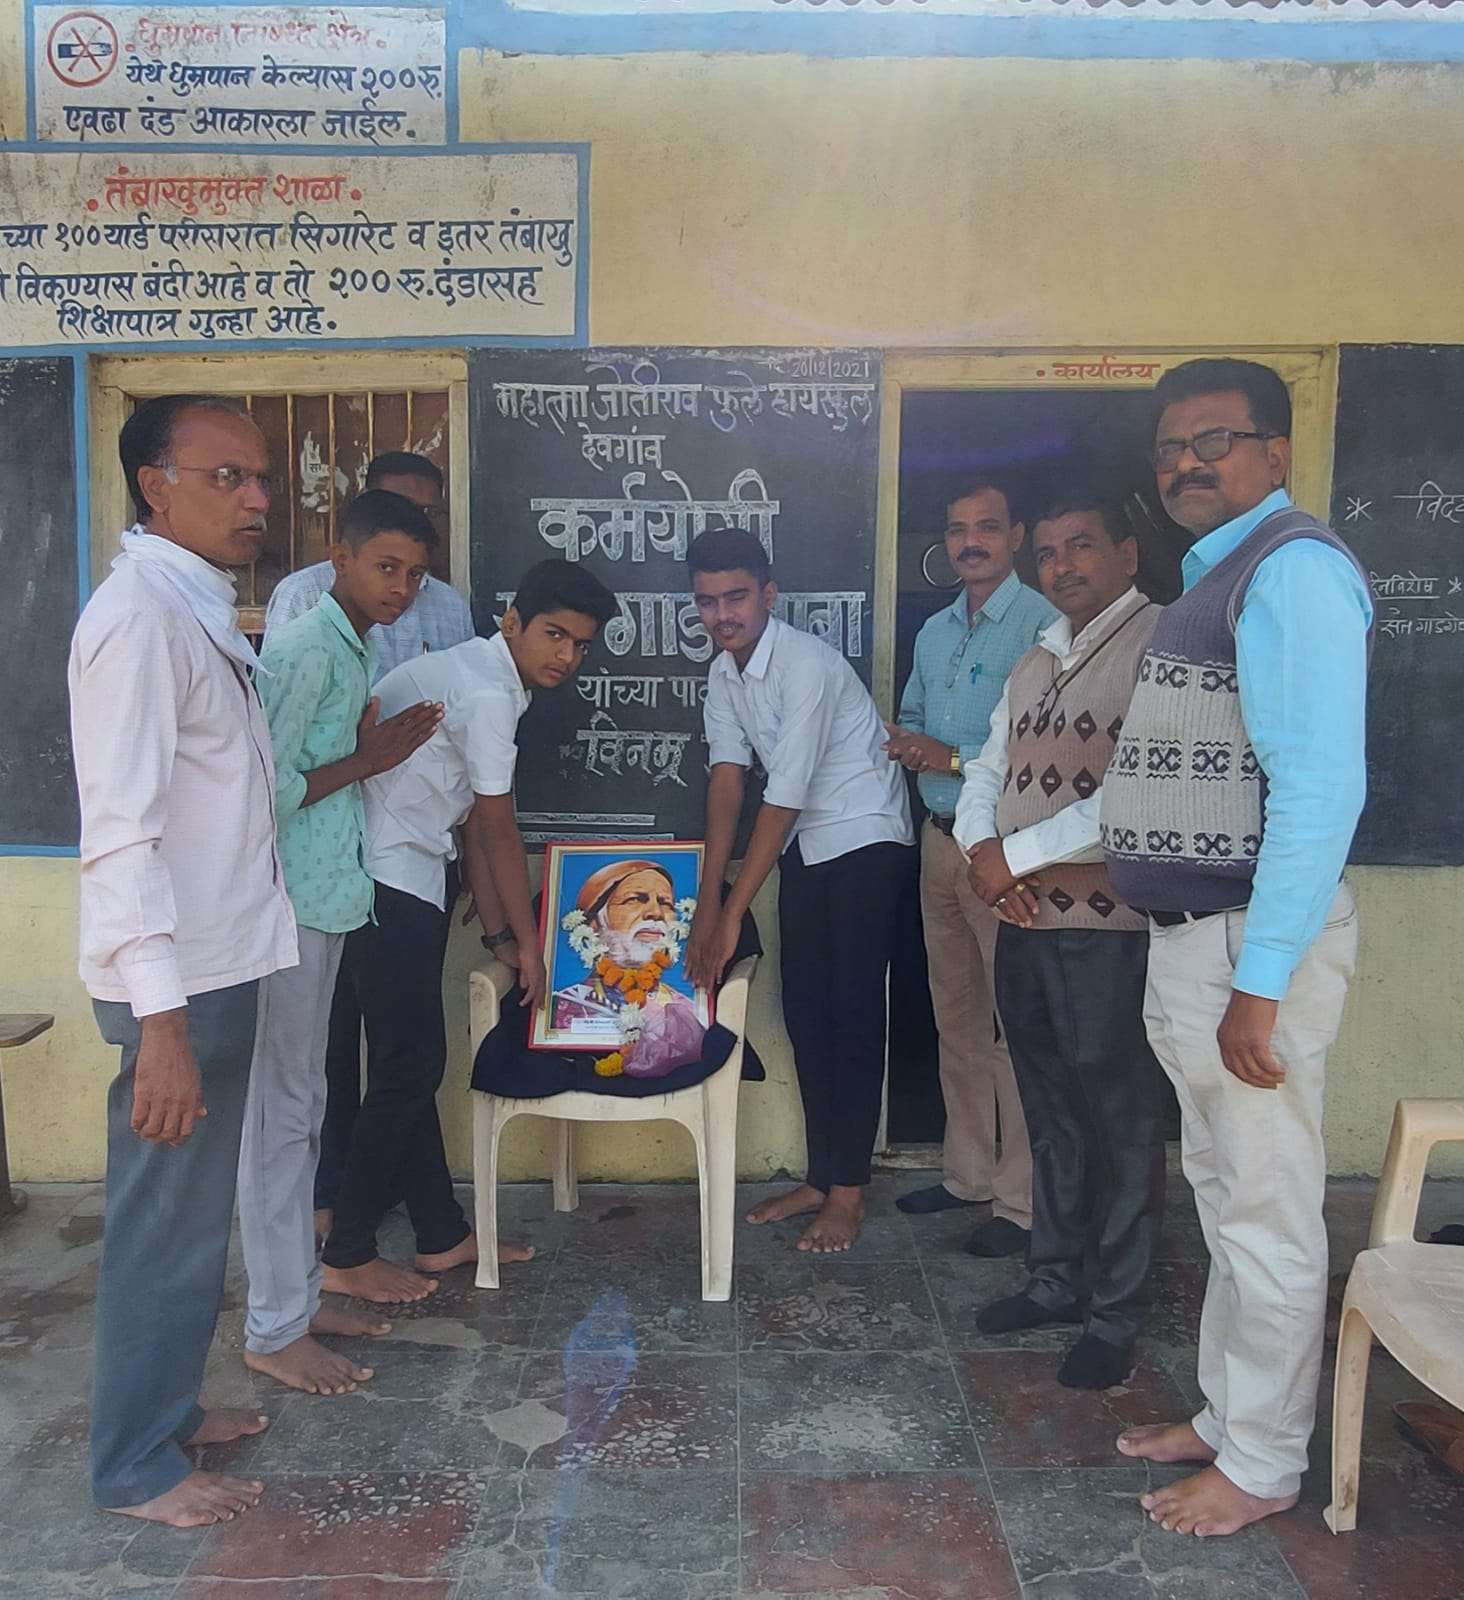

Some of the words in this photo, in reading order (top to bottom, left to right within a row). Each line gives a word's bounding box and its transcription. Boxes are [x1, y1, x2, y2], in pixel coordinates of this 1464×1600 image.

[125, 56, 167, 88] येथे
[261, 54, 358, 94] केल्यास
[63, 106, 131, 138] एवढा
[138, 95, 187, 136] दंड
[189, 105, 316, 141] आकारला
[289, 210, 398, 255] सिगारेट
[407, 220, 435, 250] व
[438, 220, 494, 255] इतर
[142, 258, 194, 300] बंदी
[195, 262, 250, 301] आहे
[254, 270, 281, 299] व
[283, 260, 316, 298] तो
[1052, 355, 1161, 380] कार्यालय
